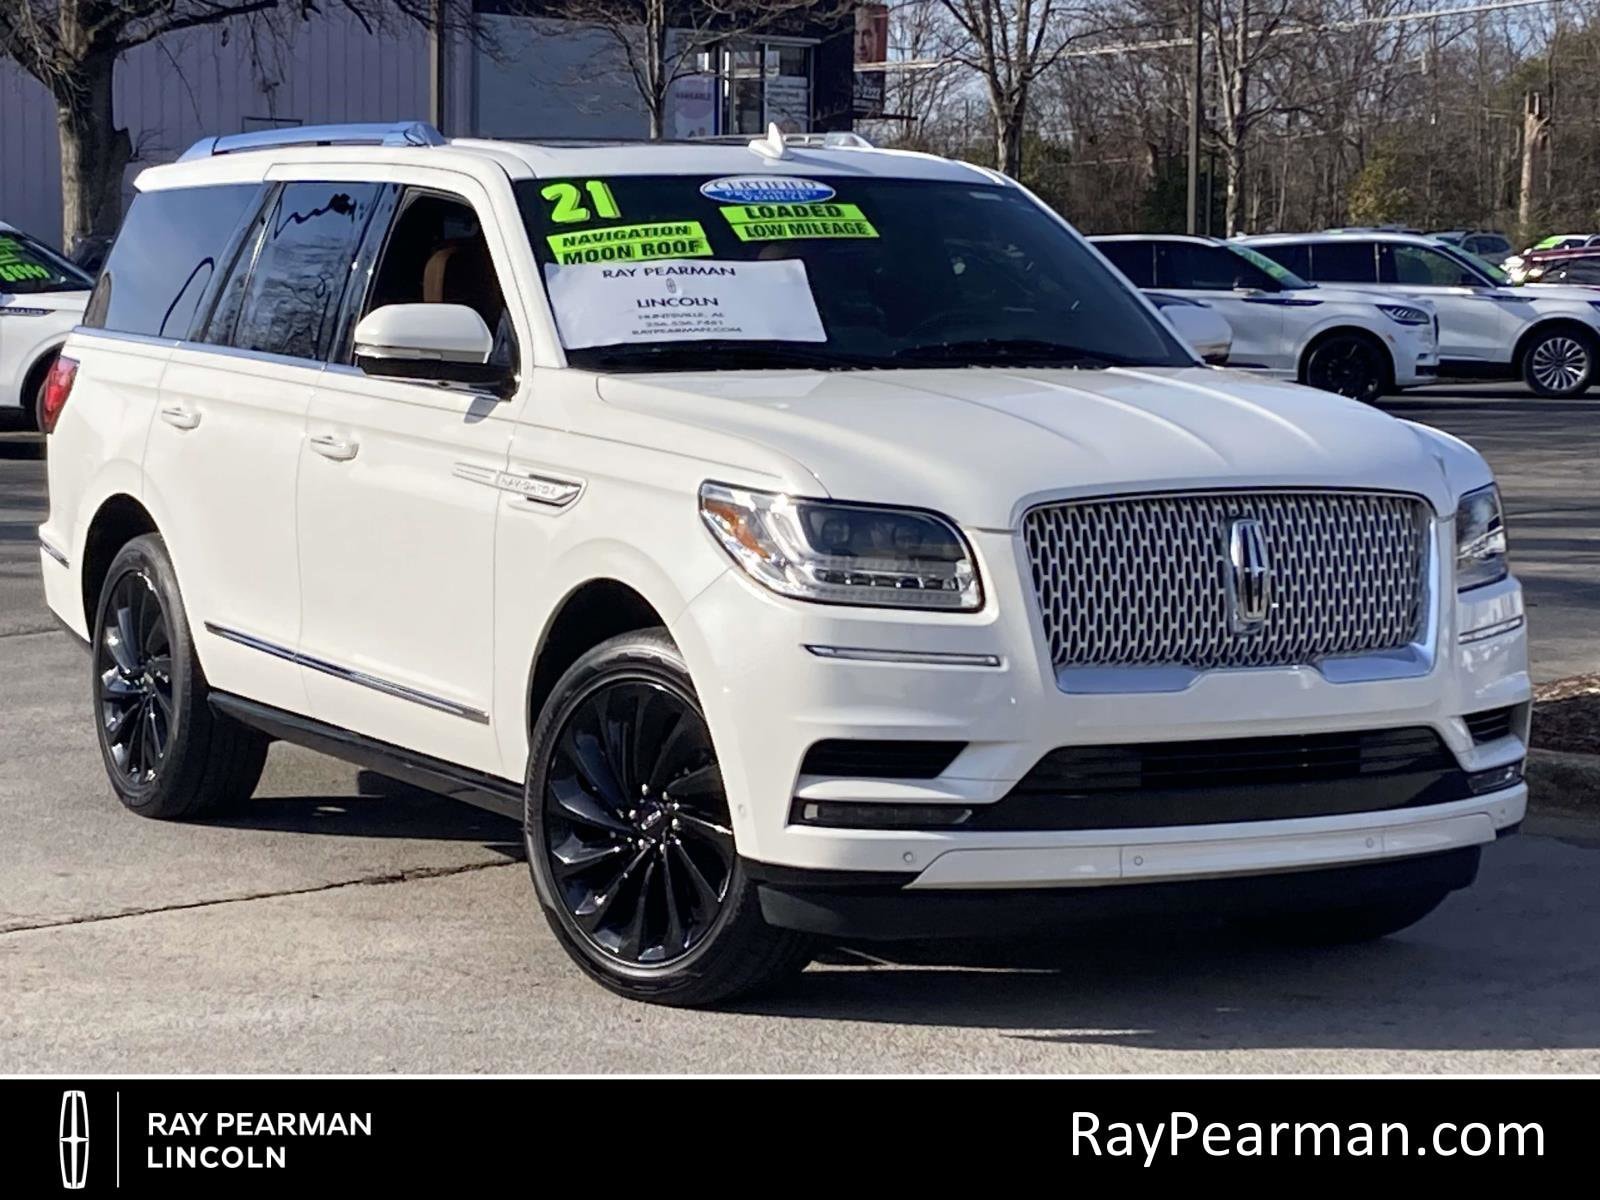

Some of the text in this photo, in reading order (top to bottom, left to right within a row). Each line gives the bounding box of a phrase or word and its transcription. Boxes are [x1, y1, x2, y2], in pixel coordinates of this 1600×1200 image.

[540, 180, 621, 223] 21
[744, 204, 844, 219] LOADED
[562, 225, 691, 247] NAVIGATION
[743, 222, 871, 238] LOW MILEAGE
[562, 240, 704, 265] MOON ROOF
[602, 266, 736, 278] RAY PEARMAN
[636, 297, 719, 308] LINCOLN
